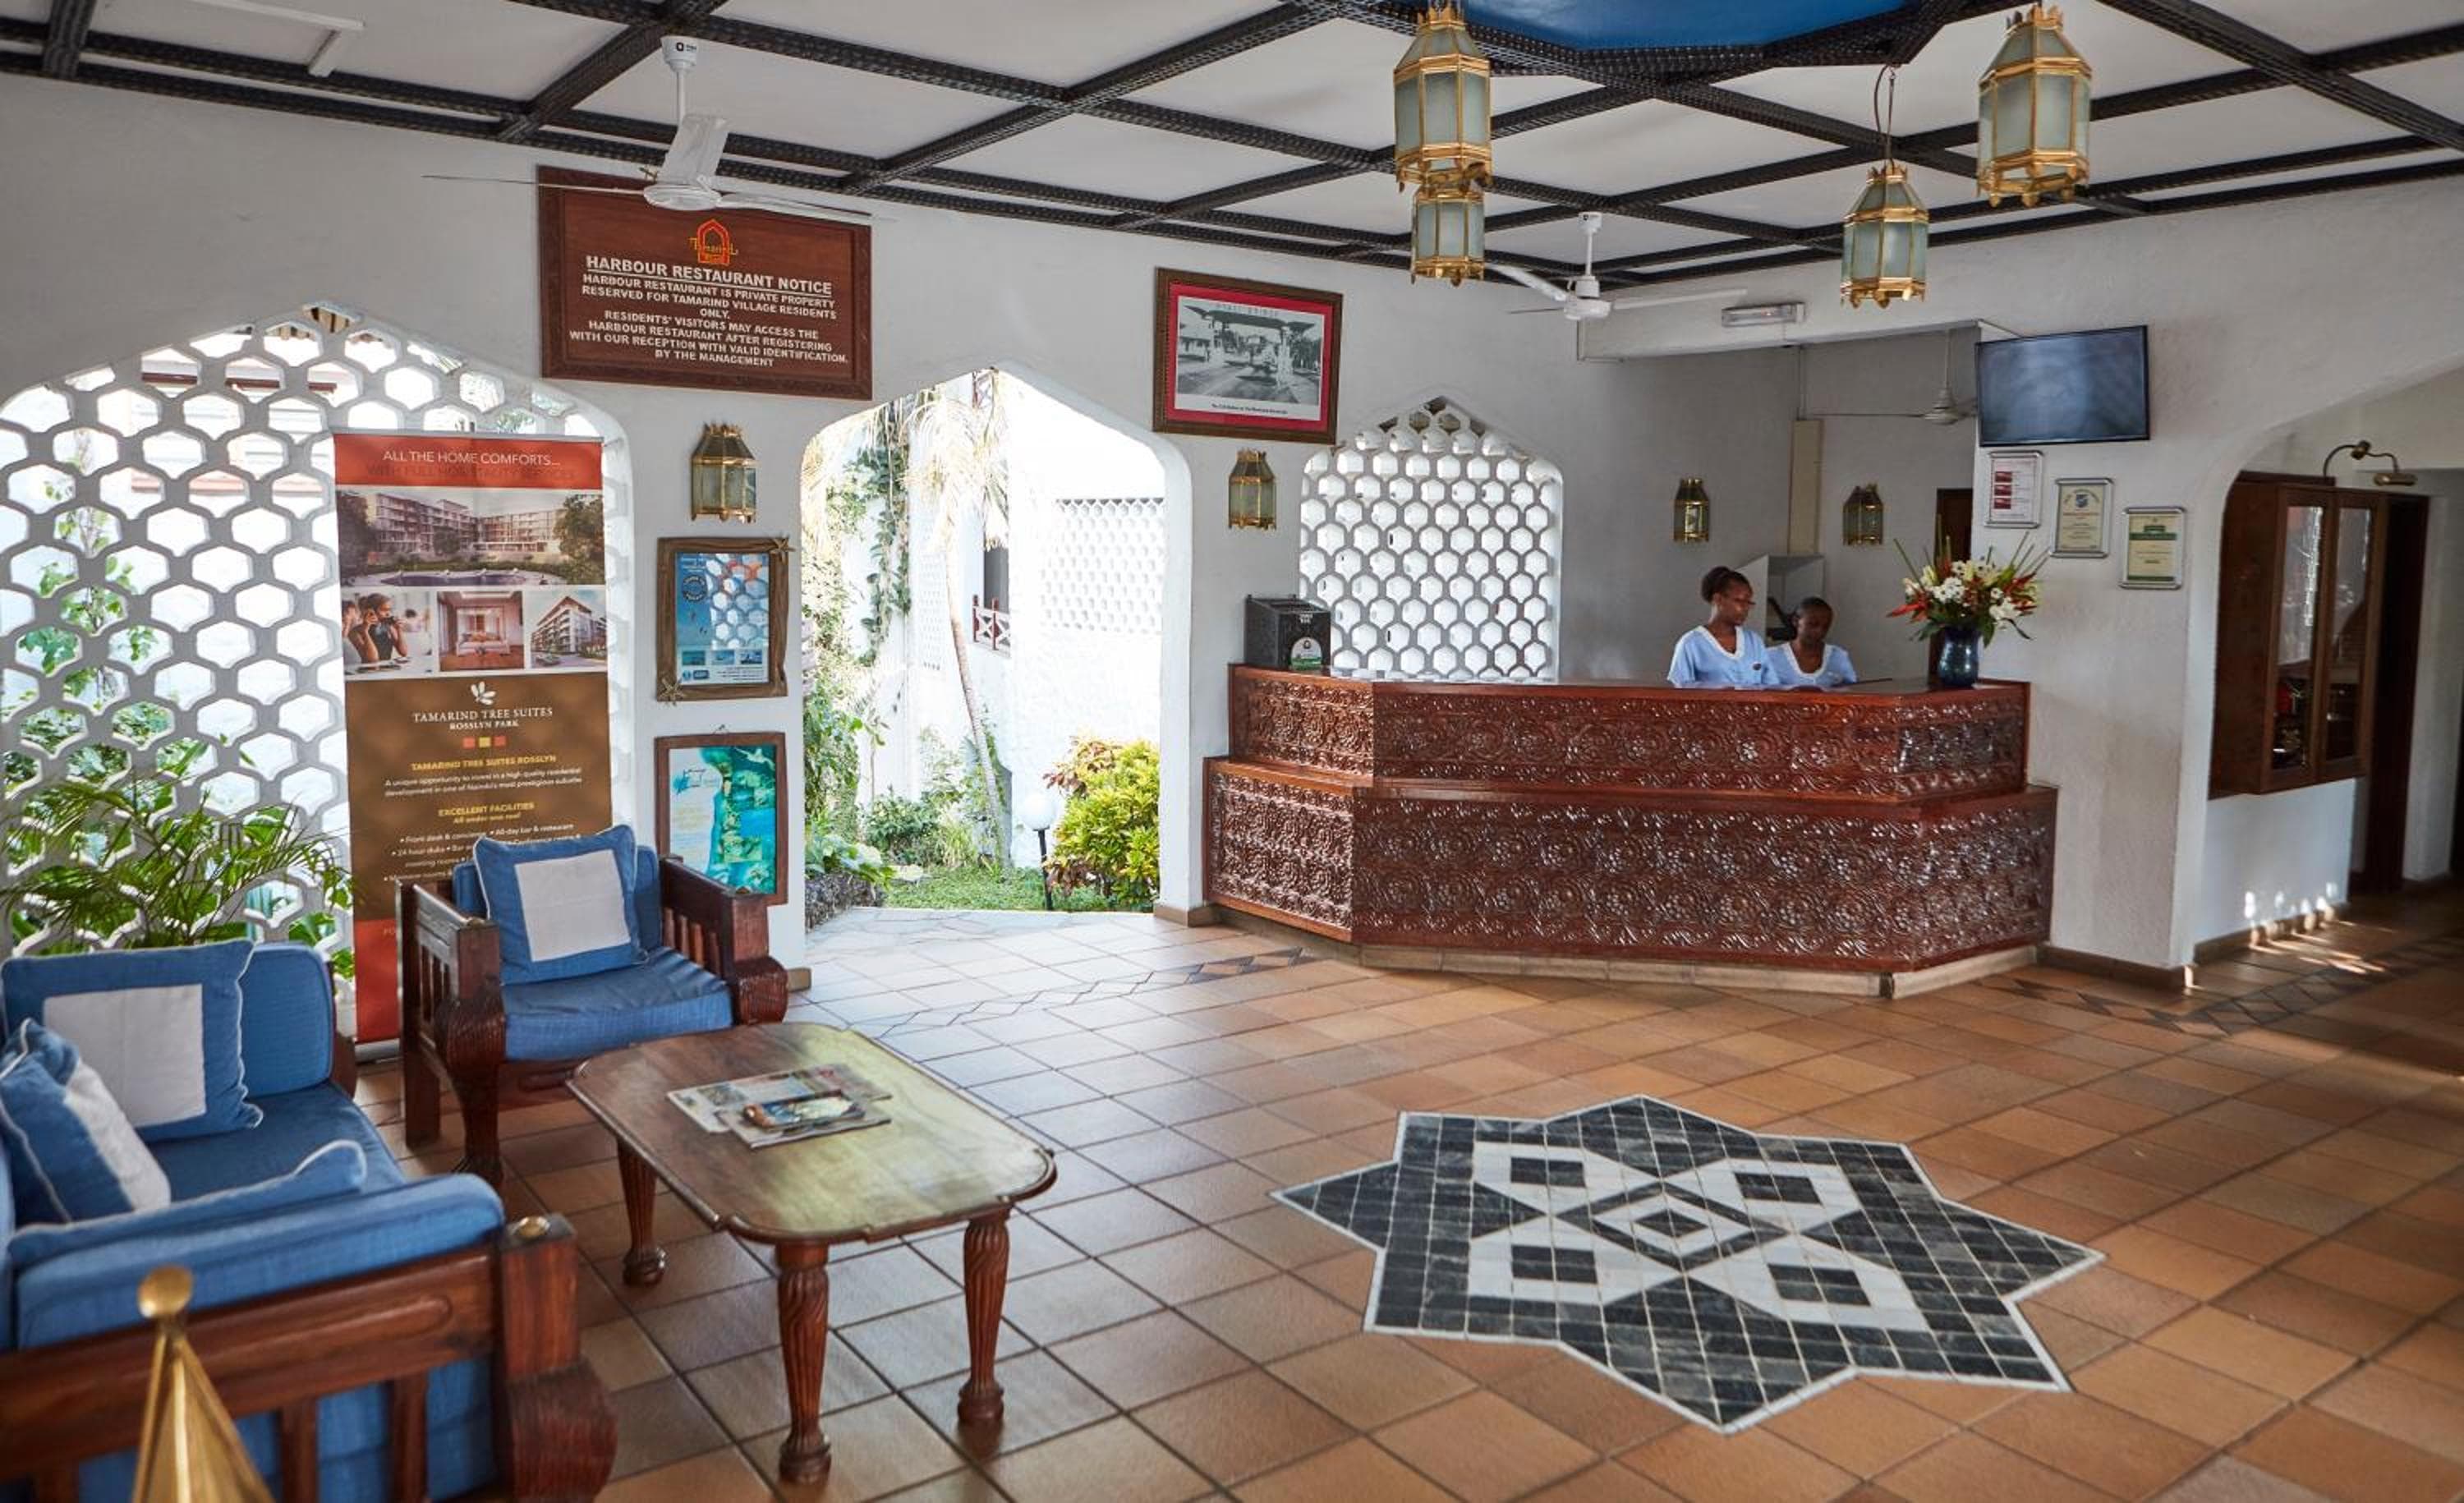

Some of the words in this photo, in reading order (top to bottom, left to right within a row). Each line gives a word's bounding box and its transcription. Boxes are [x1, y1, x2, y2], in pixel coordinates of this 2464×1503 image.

[586, 255, 668, 276] HARBOUR
[672, 264, 775, 287] RESTAURANT
[778, 278, 832, 295] NOTICE
[582, 273, 641, 287] HARBOUR
[644, 280, 718, 296] RESTAURANT
[721, 288, 733, 298] IS
[734, 289, 779, 303] PRIVATE
[781, 295, 835, 310] PROPERTY
[582, 285, 643, 300] RESERVED
[646, 292, 669, 302] FOR
[673, 293, 729, 309] TAMARIND
[733, 300, 777, 313] VILLAGE
[779, 305, 837, 319] RESIDENTS
[700, 308, 730, 319] ONLY.
[604, 310, 672, 324] RESIDENTS'
[675, 316, 725, 329] VISITORS
[729, 323, 752, 333] MAY
[754, 324, 796, 338] ACCESS
[798, 329, 819, 339] THE
[588, 319, 646, 334] HARBOUR
[649, 326, 723, 342] RESTAURANT
[725, 333, 761, 345] AFTER
[763, 337, 832, 352] REGISTERING
[569, 330, 601, 342] WITH
[604, 333, 630, 345] OUR
[632, 335, 696, 350] RECEPTION
[699, 341, 727, 353] WITH
[729, 345, 761, 356] VALID
[763, 347, 848, 364] IDENTIFICATION.
[655, 349, 671, 360] BY
[673, 351, 697, 362] THE
[699, 353, 775, 368] MANAGEMENT
[382, 450, 408, 462] ALL
[409, 451, 434, 462] THE
[438, 452, 478, 464] HOME
[413, 710, 478, 724] TAMARIND
[482, 709, 510, 721] TREE
[513, 707, 553, 719] SUITES
[449, 721, 492, 731] ROSSLYN
[494, 719, 520, 729] PARK
[411, 761, 461, 771] TAMARIND
[462, 759, 484, 768] TREE
[485, 756, 516, 766] SUITES
[517, 754, 557, 764] ROSSLYN
[438, 805, 487, 817] EXCELLENT
[489, 802, 535, 813] FACILITIES
